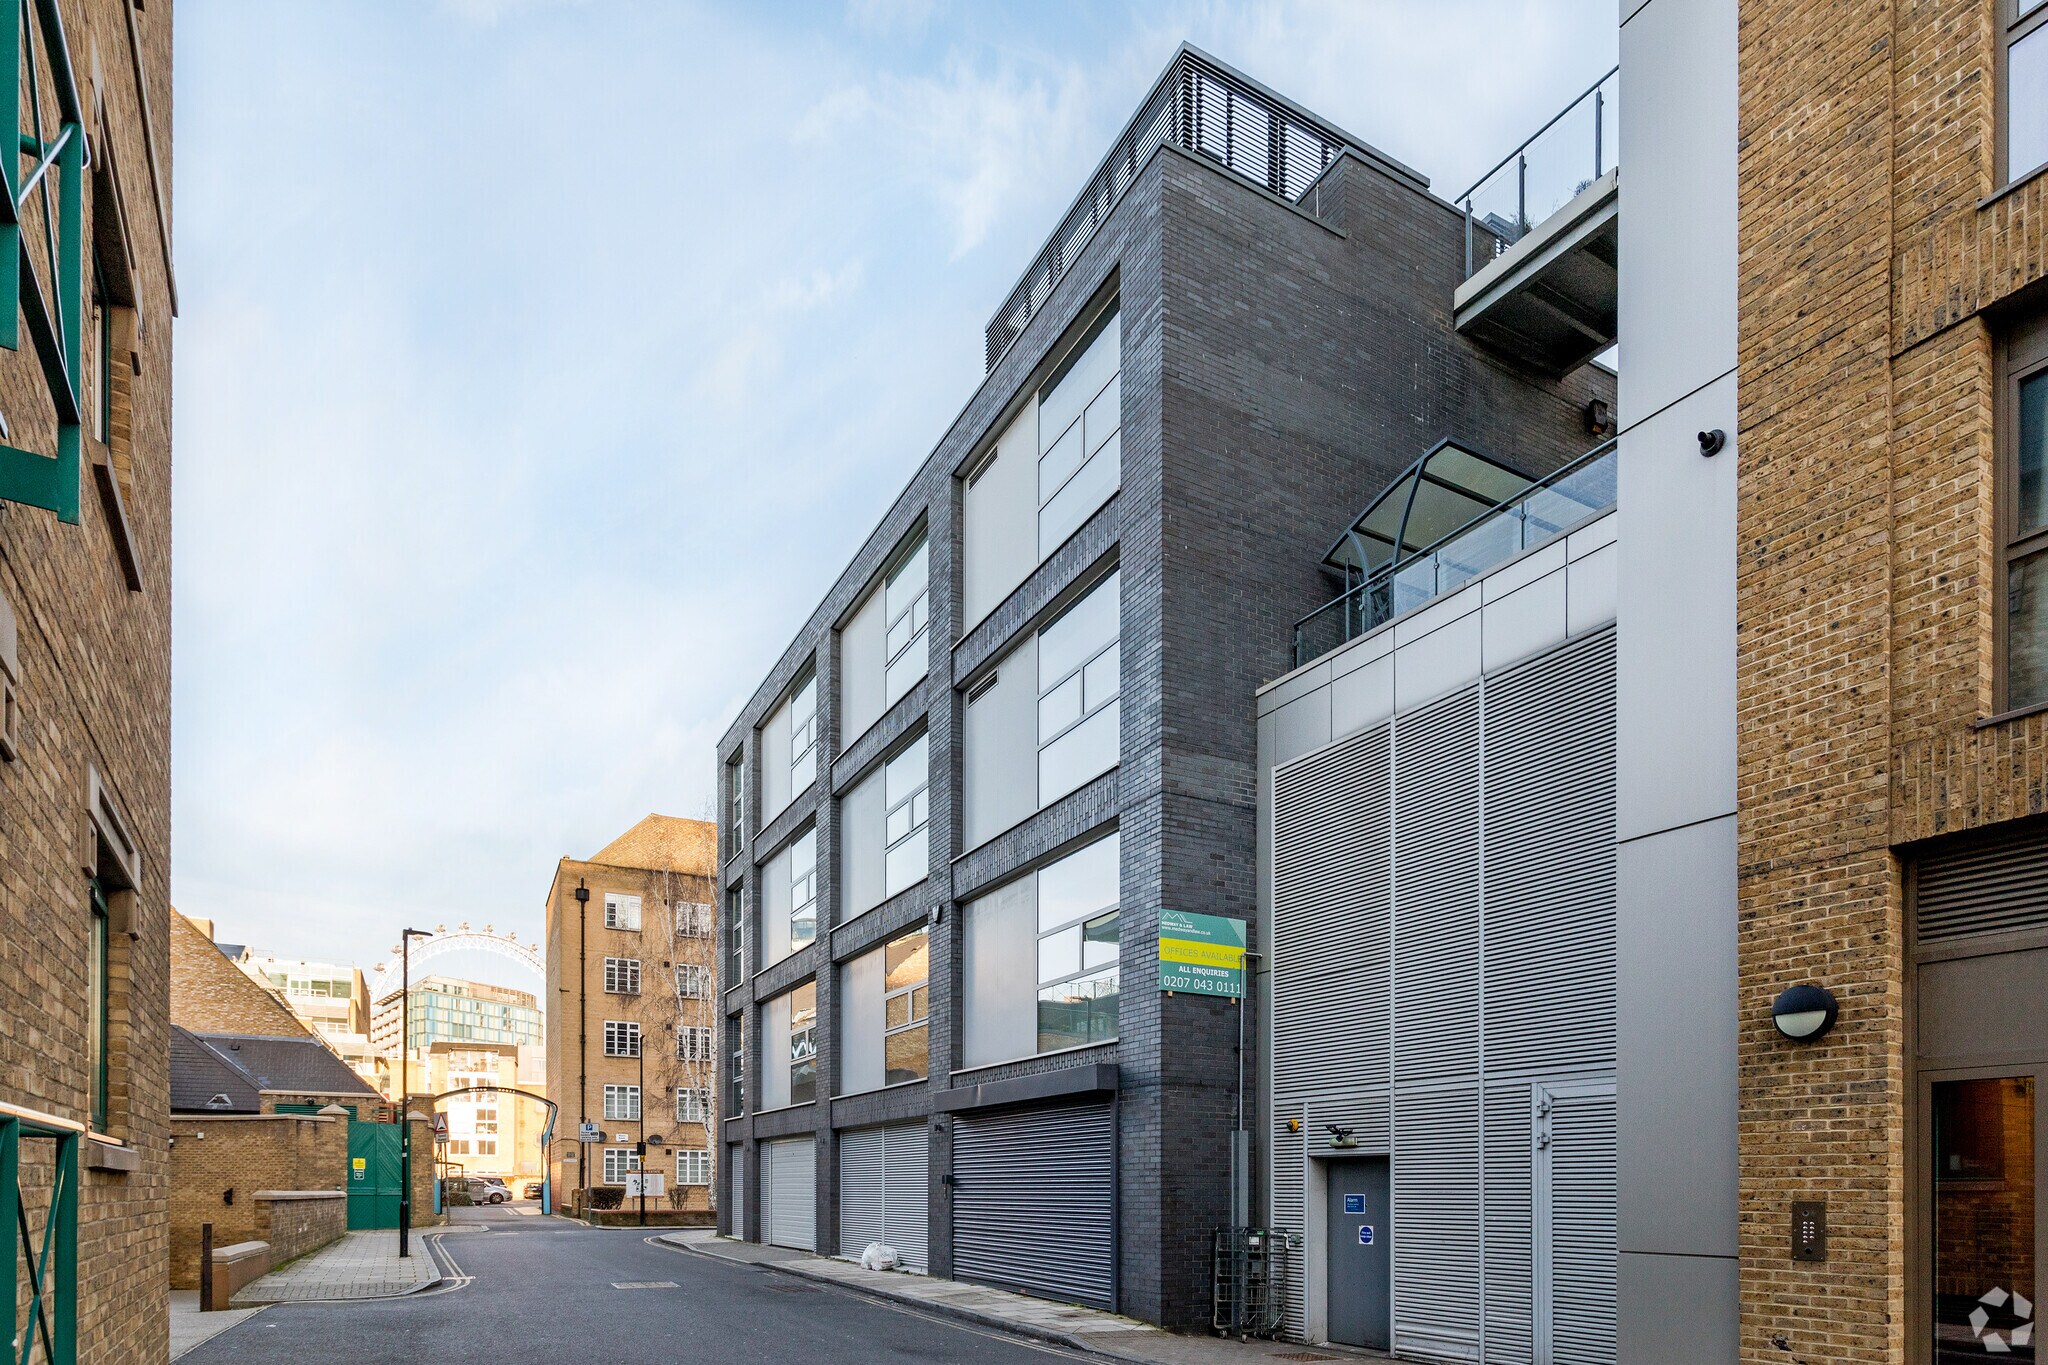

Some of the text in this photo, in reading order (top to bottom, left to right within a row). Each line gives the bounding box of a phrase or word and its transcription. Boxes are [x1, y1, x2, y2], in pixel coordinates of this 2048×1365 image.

[1164, 946, 1242, 963] OFFICES AVAILABLE
[1178, 965, 1229, 978] ALL ENQUIRIES
[1163, 975, 1241, 994] 0207 043 0111
